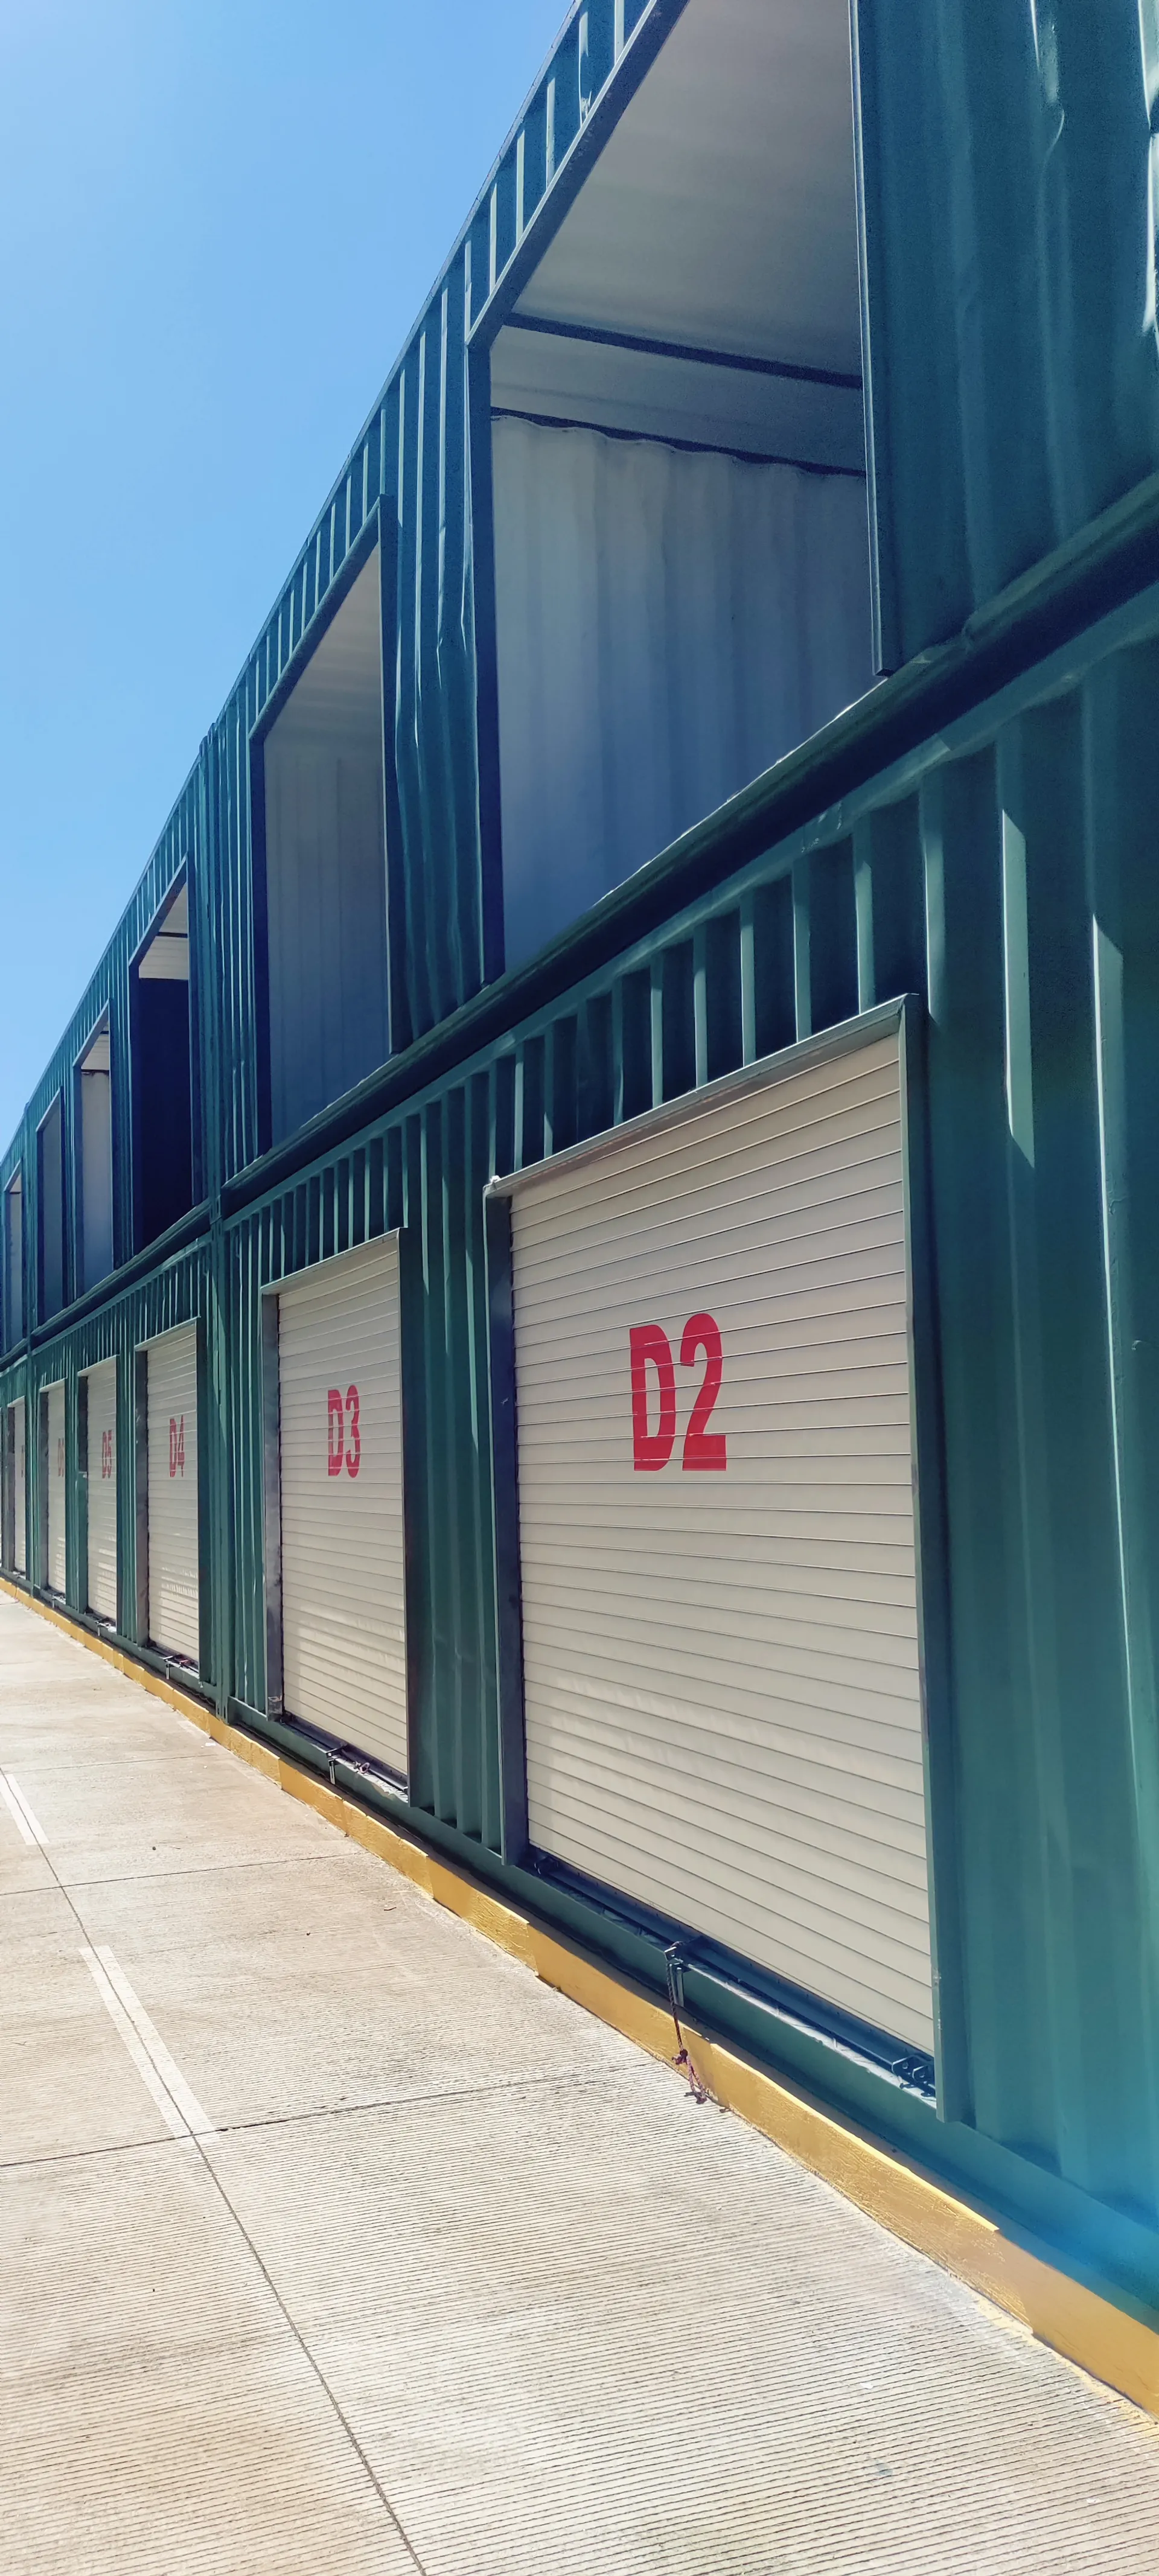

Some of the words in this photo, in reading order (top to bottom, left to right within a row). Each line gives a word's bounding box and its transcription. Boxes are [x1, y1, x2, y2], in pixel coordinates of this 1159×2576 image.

[630, 1313, 727, 1471] D2
[102, 1429, 112, 1479] D5
[170, 1415, 185, 1478] D4
[328, 1385, 361, 1478] D3
